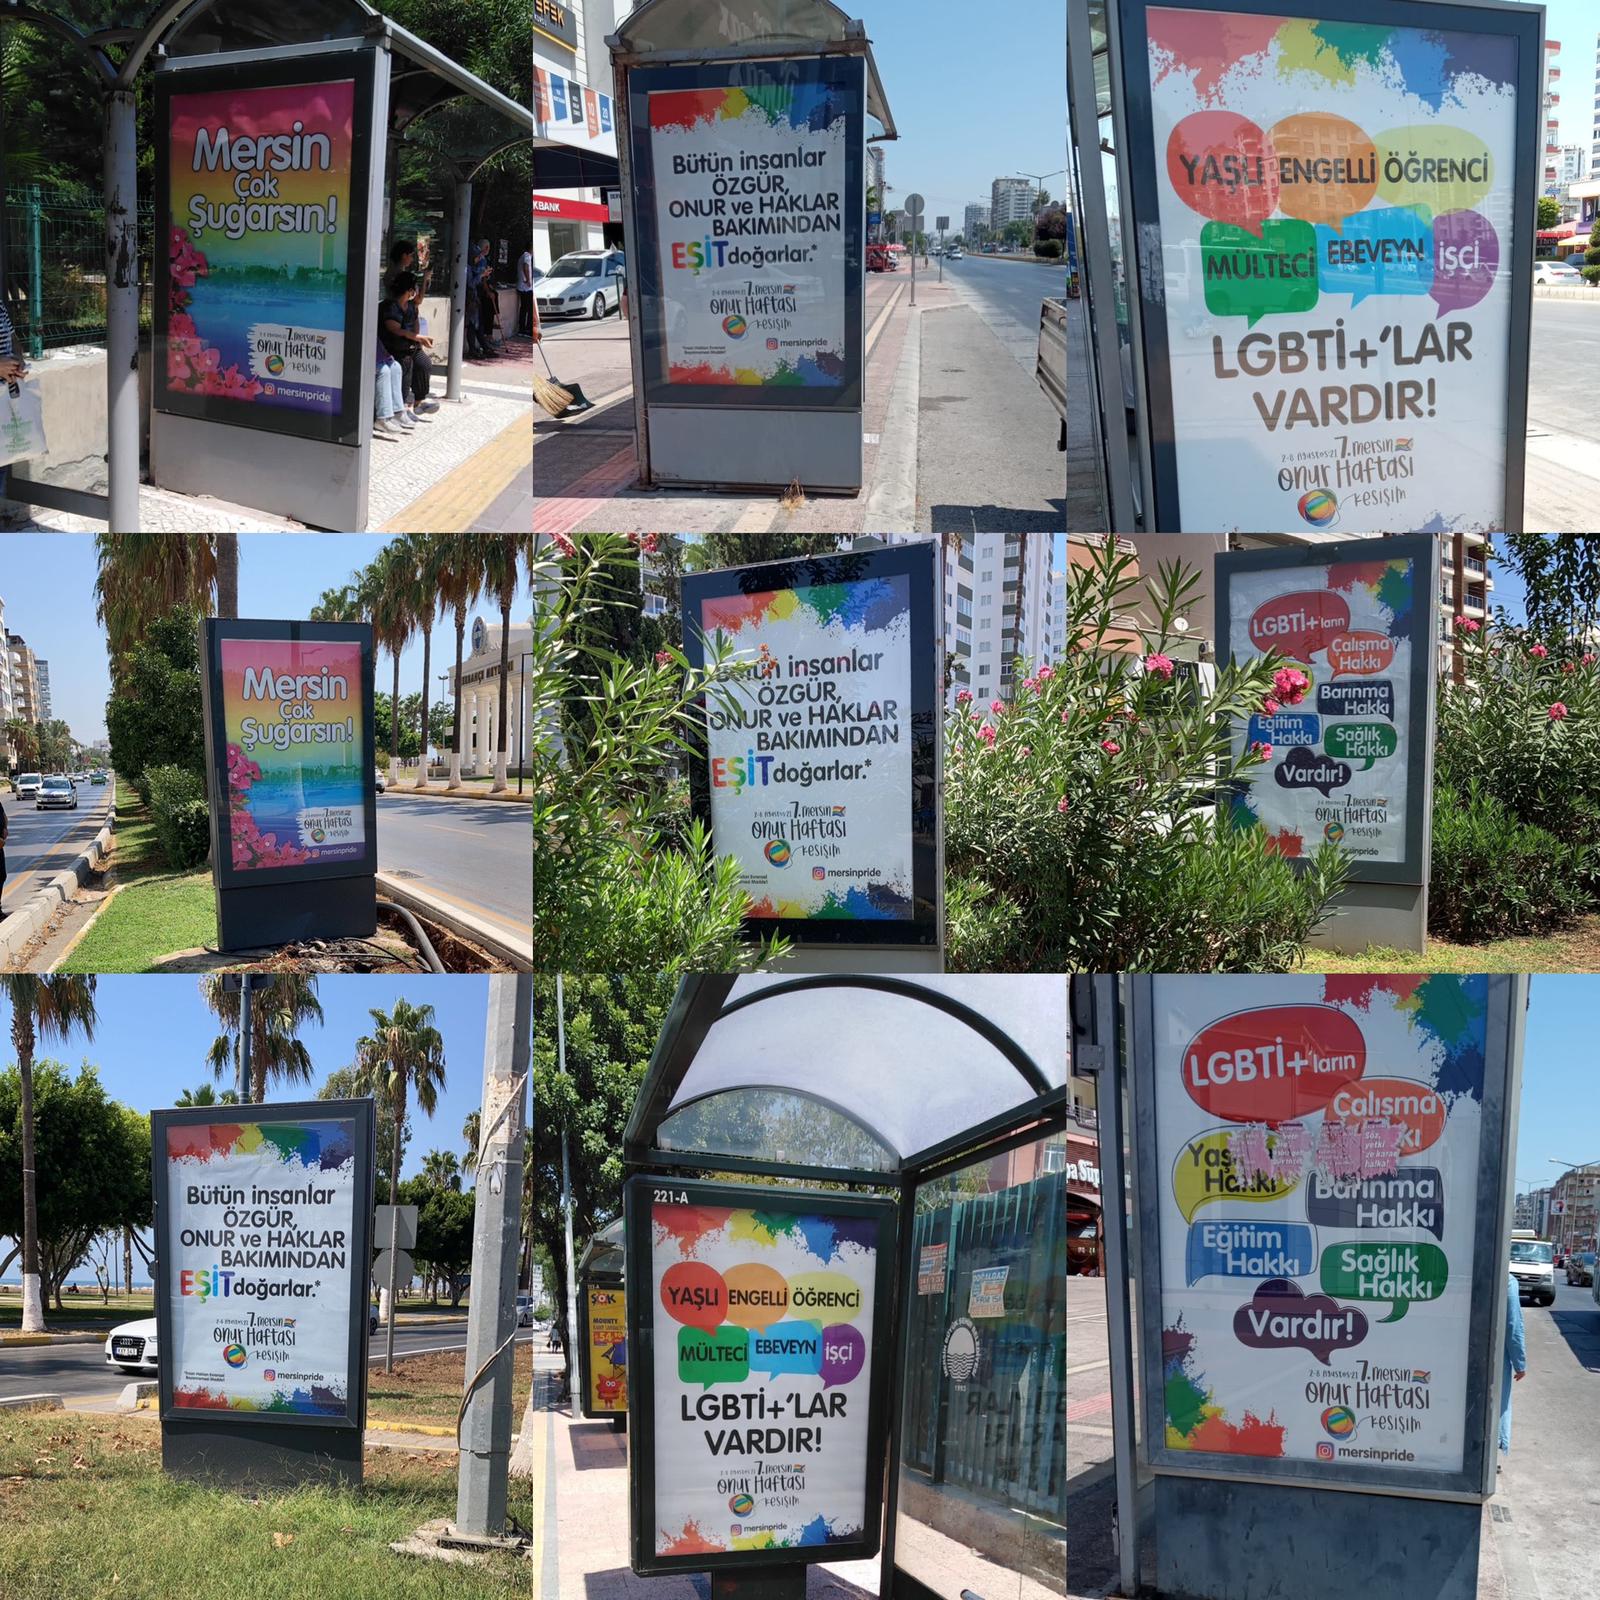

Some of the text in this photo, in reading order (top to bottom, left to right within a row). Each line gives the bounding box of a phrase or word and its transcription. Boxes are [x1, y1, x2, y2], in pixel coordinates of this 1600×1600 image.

[192, 120, 332, 172] Mersin
[672, 146, 827, 174] Bütün insanlar
[1179, 150, 1489, 194] YAŞLI ENGELLİ ÖĞRENCİ
[233, 170, 279, 204] Çok
[712, 171, 790, 196] ÖZGÜR,
[188, 194, 338, 239] Şugarsın!
[669, 193, 839, 218] ONUR ve HAKLAR
[713, 213, 841, 236] BAKIMINDAN
[672, 234, 730, 276] EŞİT
[1206, 245, 1316, 281] MÜLTECİ
[1328, 238, 1425, 264] EBEVEYN
[745, 296, 797, 315] Haftası
[780, 338, 828, 348] mersinpride
[1212, 318, 1473, 379] LGBTİ+'LAR
[277, 388, 331, 402] mersinpride
[1252, 377, 1436, 432] VARDIR!
[1336, 455, 1414, 488] Haftası
[1331, 638, 1390, 654] Çalışma
[788, 648, 884, 678] insanlar
[1340, 652, 1380, 670] Hakkı
[242, 665, 348, 700] Mersin
[758, 678, 842, 706] ÖZGÜR,
[1321, 685, 1389, 699] Barınma
[279, 700, 314, 724] Çok
[710, 700, 898, 731] ONUR ve HAKLAR
[1345, 700, 1390, 715] Hakkı
[241, 716, 354, 752] Şugarsın!
[757, 724, 899, 751] BAKIMINDAN
[1270, 730, 1312, 744] Hakkı
[1336, 727, 1380, 746] Sağlık
[1346, 742, 1388, 757] Hakkı
[712, 749, 774, 795] EŞİT
[1282, 765, 1344, 783] Vardır!
[790, 818, 846, 840] Haftası
[828, 868, 882, 880] mersinpride
[187, 1184, 336, 1205] Bütün insanlar
[653, 1190, 688, 1204] 221-A
[223, 1206, 298, 1231] ÖZGÜR,
[1356, 1202, 1434, 1228] Hakkı
[180, 1229, 346, 1248] ONUR ve HAKLAR
[1203, 1225, 1282, 1255] Eğitim
[221, 1250, 346, 1270] BAKIMINDAN
[1226, 1252, 1300, 1276] Hakkı
[1340, 1248, 1420, 1279] Sağlık
[180, 1264, 236, 1304] EŞİT
[1358, 1274, 1432, 1300] Hakkı
[668, 1286, 860, 1311] YAŞLI ENGELLİ ÖĞRENCİ
[246, 1327, 296, 1346] Haftası
[1248, 1309, 1353, 1341] Vardır!
[680, 1339, 852, 1365] MÜLTECİ EBEVEYN İŞÇİ
[277, 1372, 324, 1382] mersinpride
[681, 1387, 848, 1422] LGBTİ+'LAR
[1356, 1381, 1430, 1409] Haftası
[704, 1427, 822, 1456] VARDIR!
[1338, 1448, 1415, 1462] mersinpride
[754, 1474, 806, 1494] Haftası
[744, 1522, 788, 1532] mersinpride
